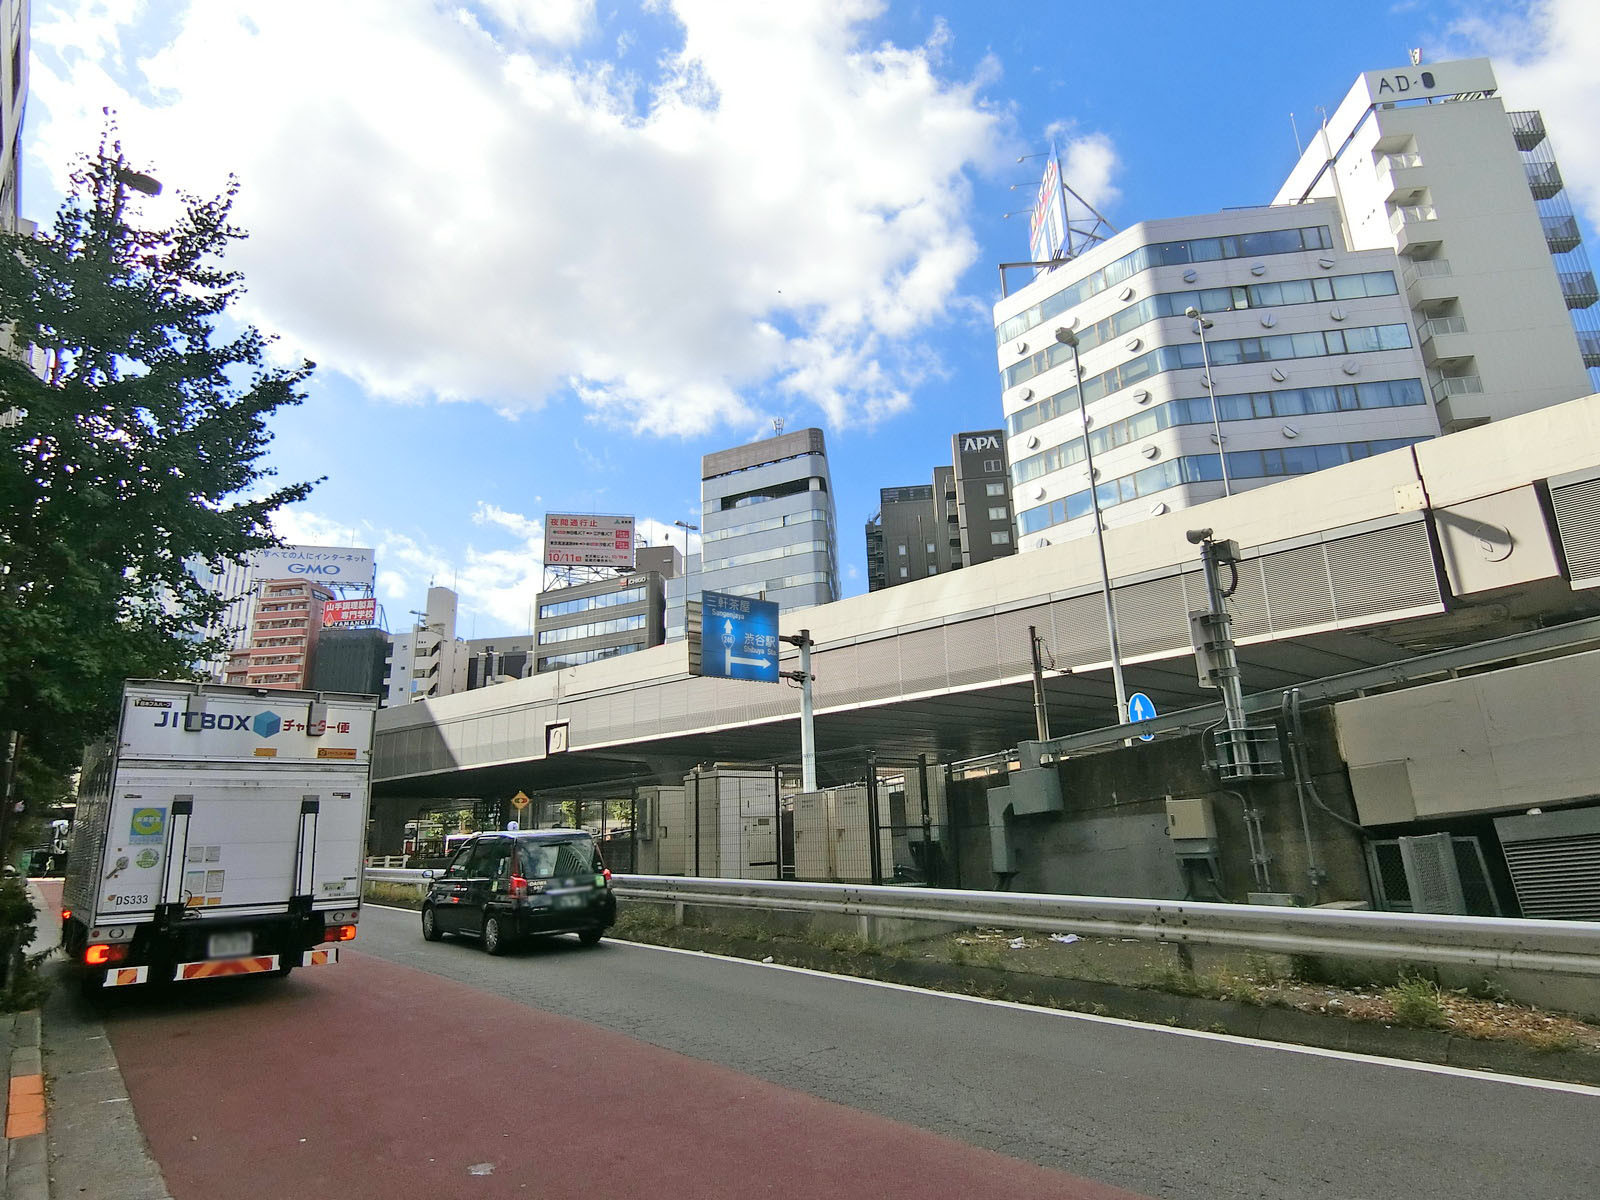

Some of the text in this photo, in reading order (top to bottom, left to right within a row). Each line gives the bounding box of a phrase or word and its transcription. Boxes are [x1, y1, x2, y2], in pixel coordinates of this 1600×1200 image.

[964, 436, 999, 453] APA
[550, 518, 598, 528] 夜間通行止
[548, 553, 574, 562] 10/11
[287, 563, 341, 575] GMO
[706, 595, 751, 613] 三軒茶屋
[744, 632, 776, 648] 渋谷駅
[743, 645, 765, 655] Shibuya
[154, 711, 252, 732] JITBOX
[283, 719, 351, 734] チャーター便
[115, 895, 149, 906] DS333
